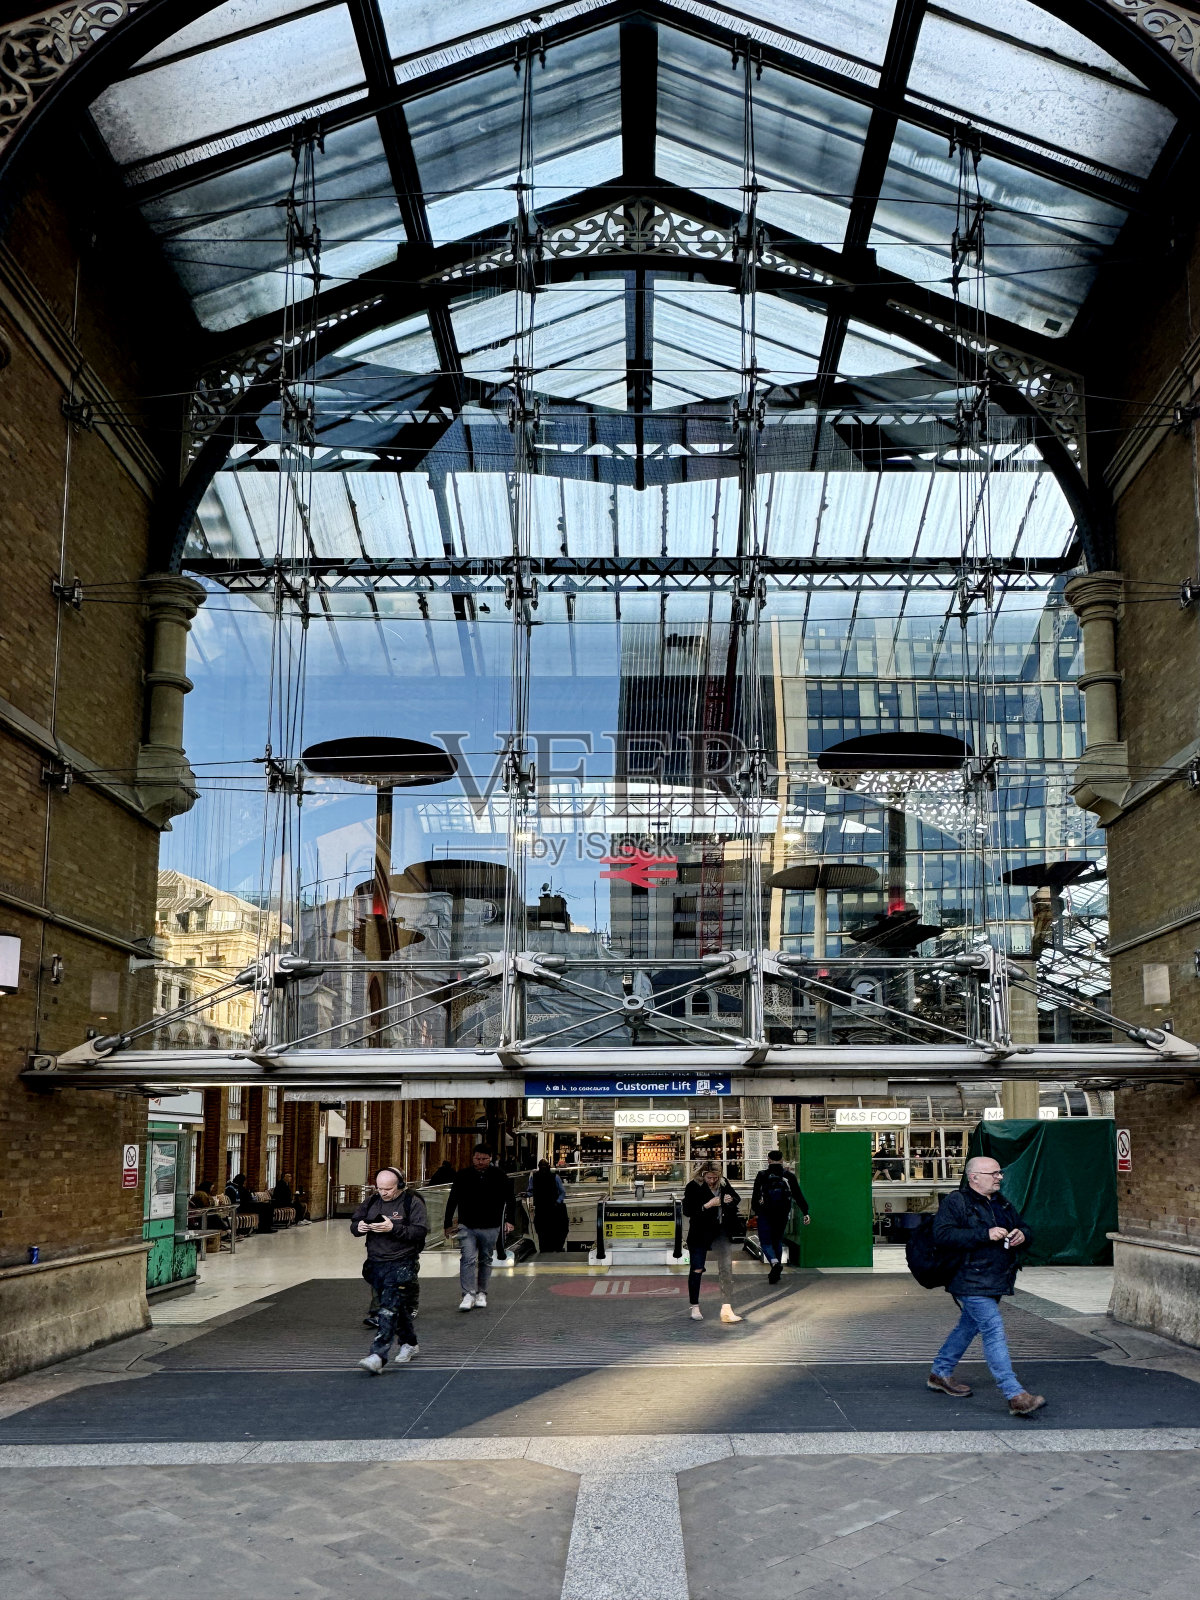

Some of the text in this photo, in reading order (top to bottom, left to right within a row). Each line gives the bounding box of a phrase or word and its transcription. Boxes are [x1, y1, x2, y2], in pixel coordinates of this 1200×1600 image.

[615, 1081, 691, 1091] Customer Lift
[618, 1113, 686, 1123] M&S FOOD
[839, 1111, 907, 1121] M&S FOOD
